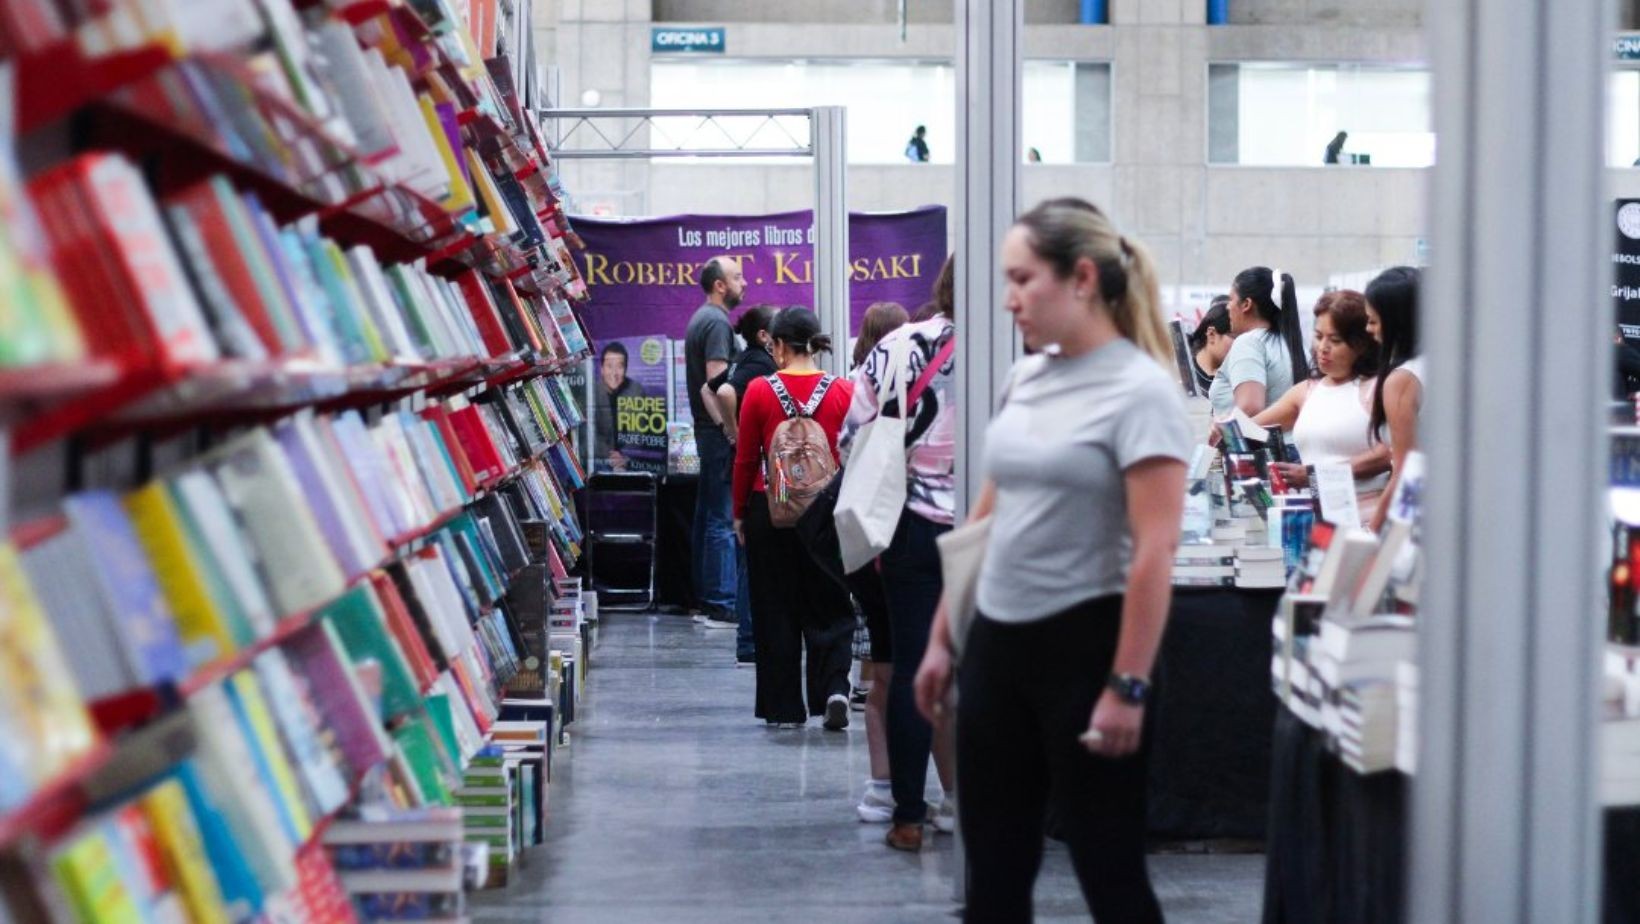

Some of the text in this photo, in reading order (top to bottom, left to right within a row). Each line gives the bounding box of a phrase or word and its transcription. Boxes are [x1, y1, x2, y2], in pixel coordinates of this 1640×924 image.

[656, 31, 720, 45] OFICINA 3
[678, 226, 702, 247] Los
[706, 227, 760, 250] mejores
[764, 225, 803, 245] libros
[617, 396, 666, 412] PADRE
[617, 413, 666, 433] RICO
[618, 433, 667, 447] PADRE POBRE
